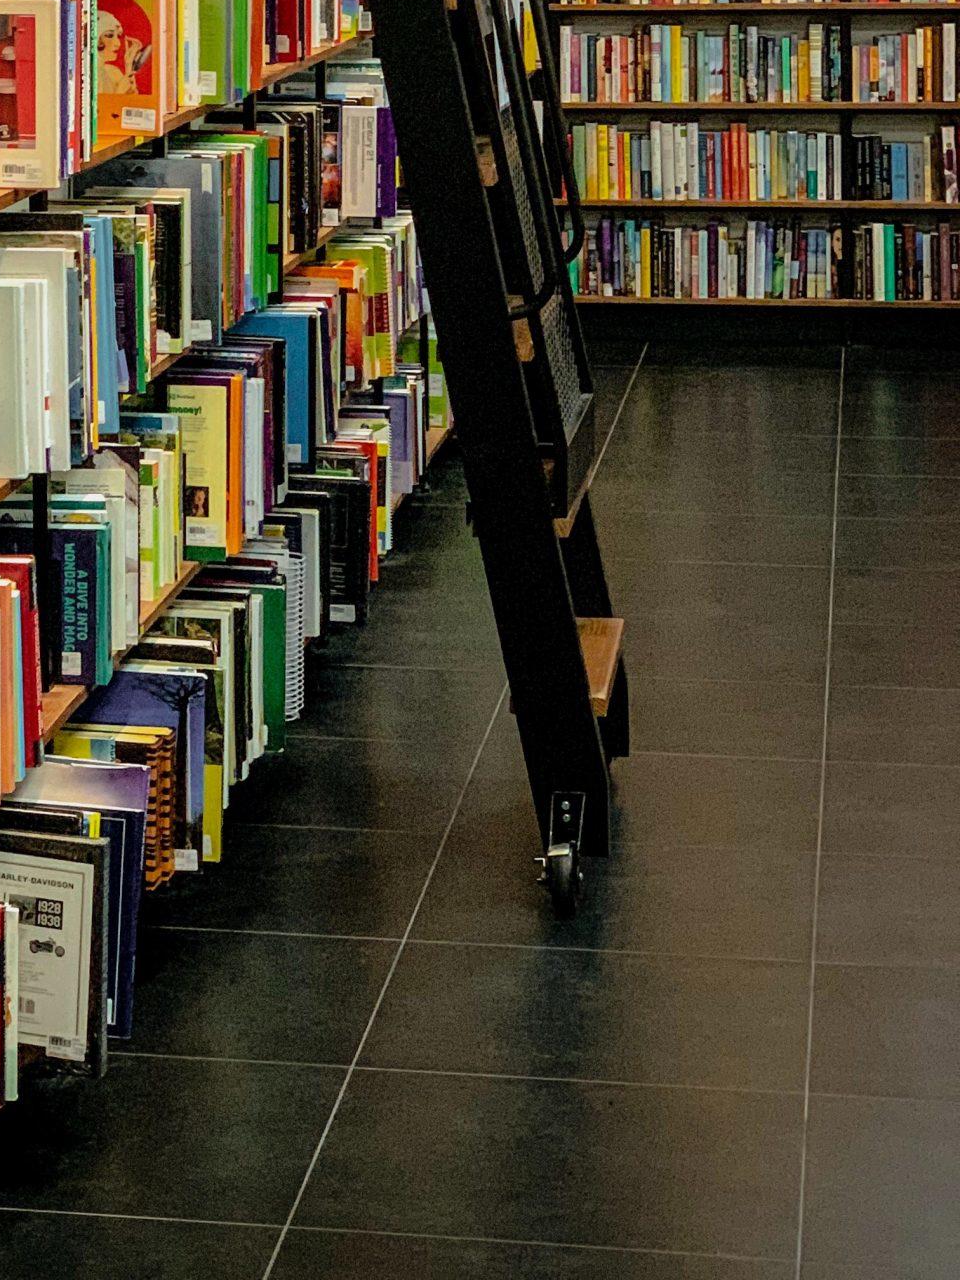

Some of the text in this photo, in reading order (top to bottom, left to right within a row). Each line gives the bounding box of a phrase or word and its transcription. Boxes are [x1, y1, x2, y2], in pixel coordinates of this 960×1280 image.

[64, 543, 75, 652] WONDER AND MAG
[77, 570, 88, 640] A DIVE INTO
[37, 913, 61, 928] 1938
[38, 899, 62, 914] 1928
